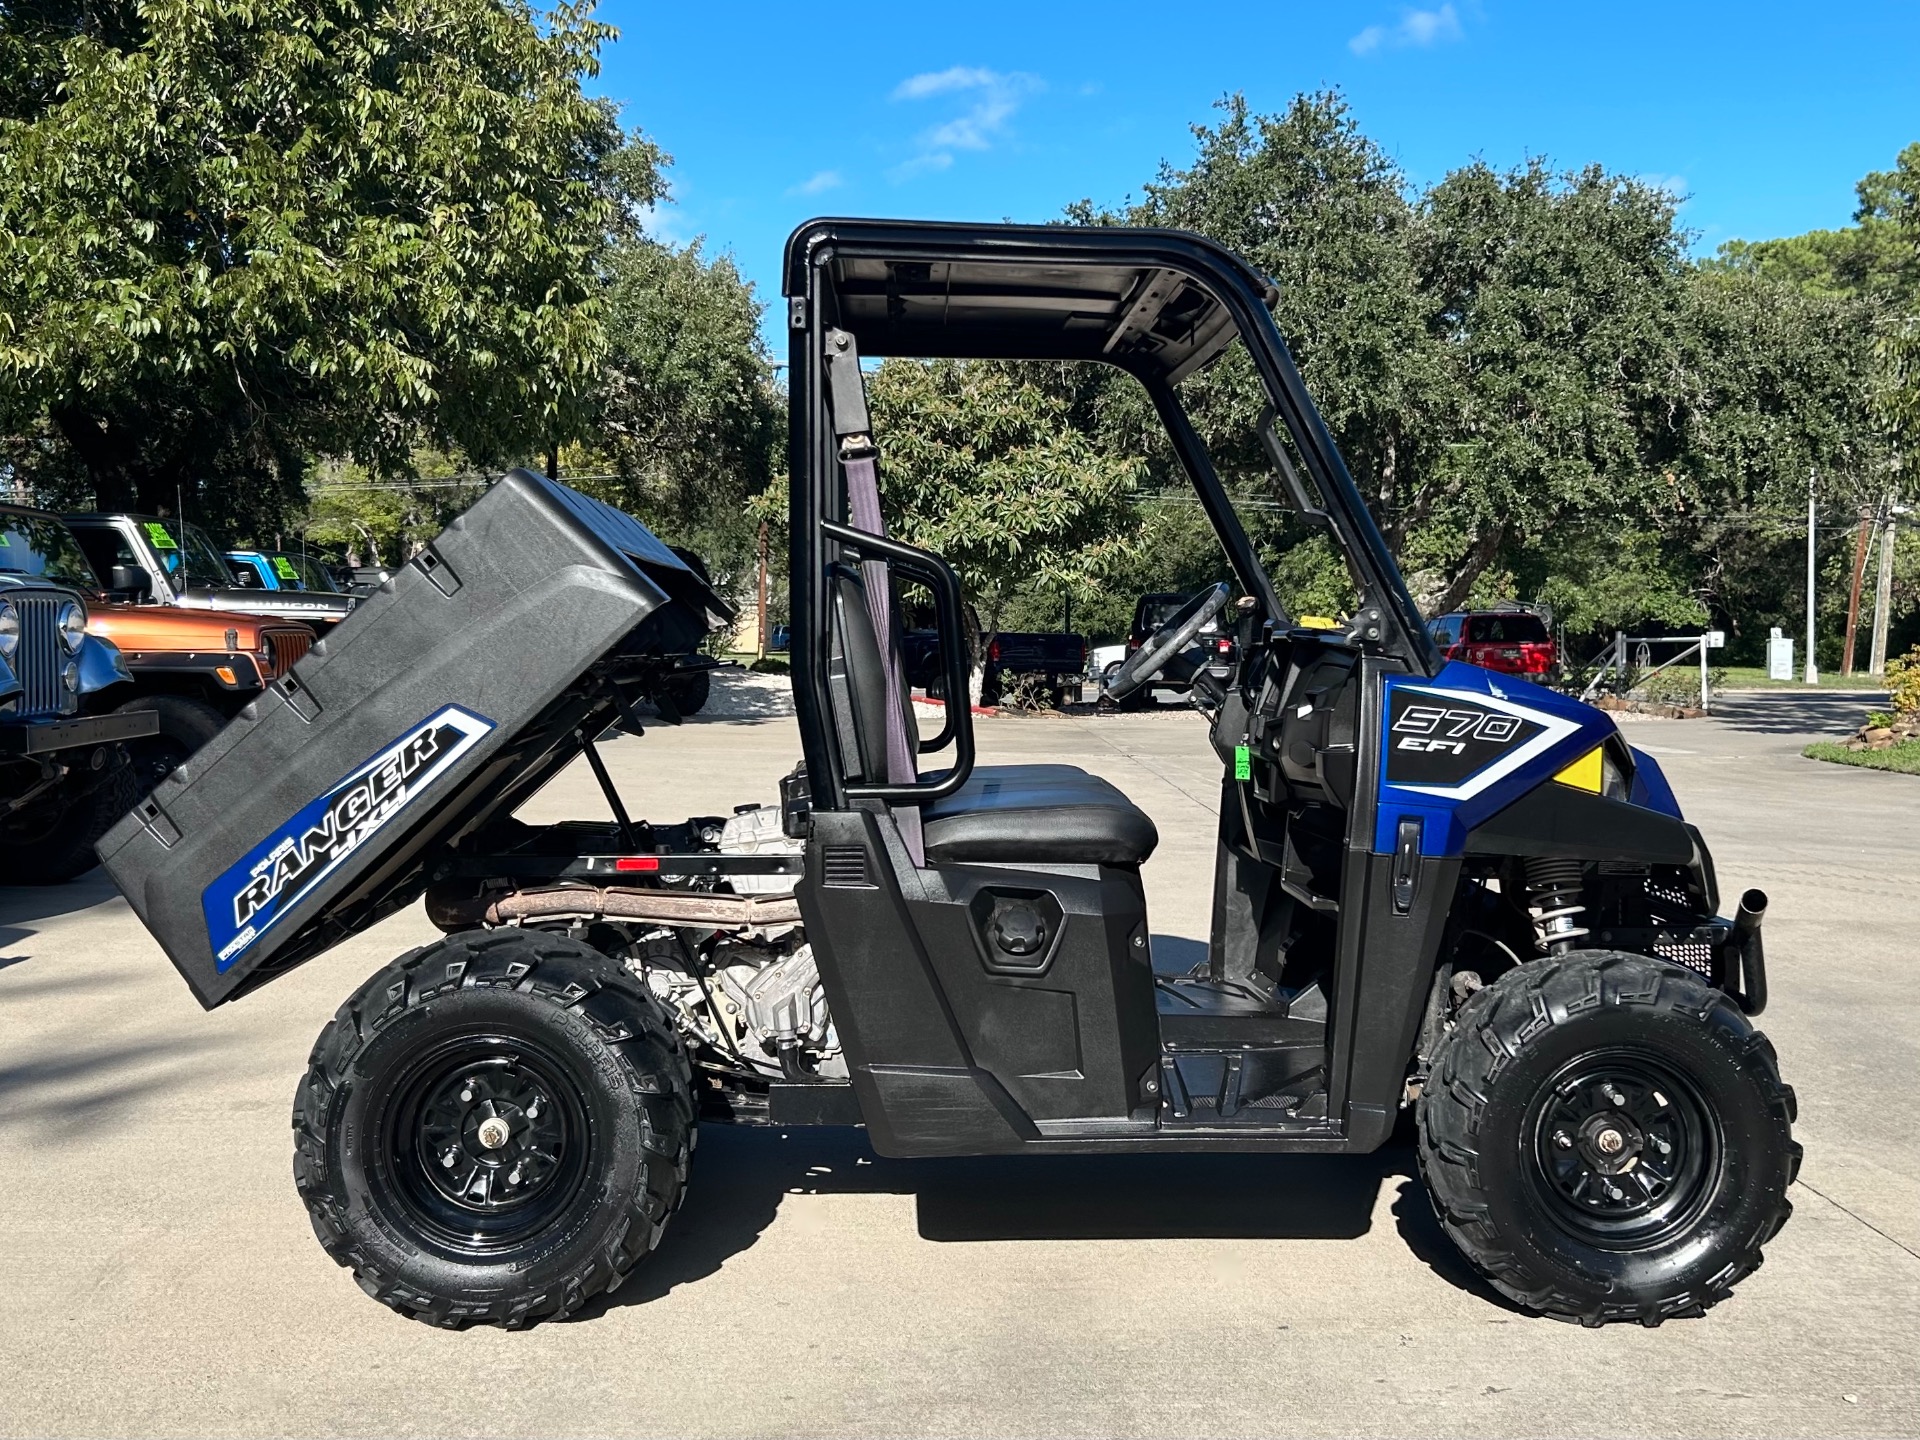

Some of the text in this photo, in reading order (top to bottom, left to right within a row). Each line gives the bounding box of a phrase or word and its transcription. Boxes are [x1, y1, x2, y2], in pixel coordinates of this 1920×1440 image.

[246, 602, 330, 610] UBICON
[1392, 705, 1522, 742] 570
[1397, 737, 1466, 755] EFI
[233, 727, 438, 929] RANGER
[250, 836, 295, 877] POLARIS
[550, 1011, 625, 1090] POLARIS
